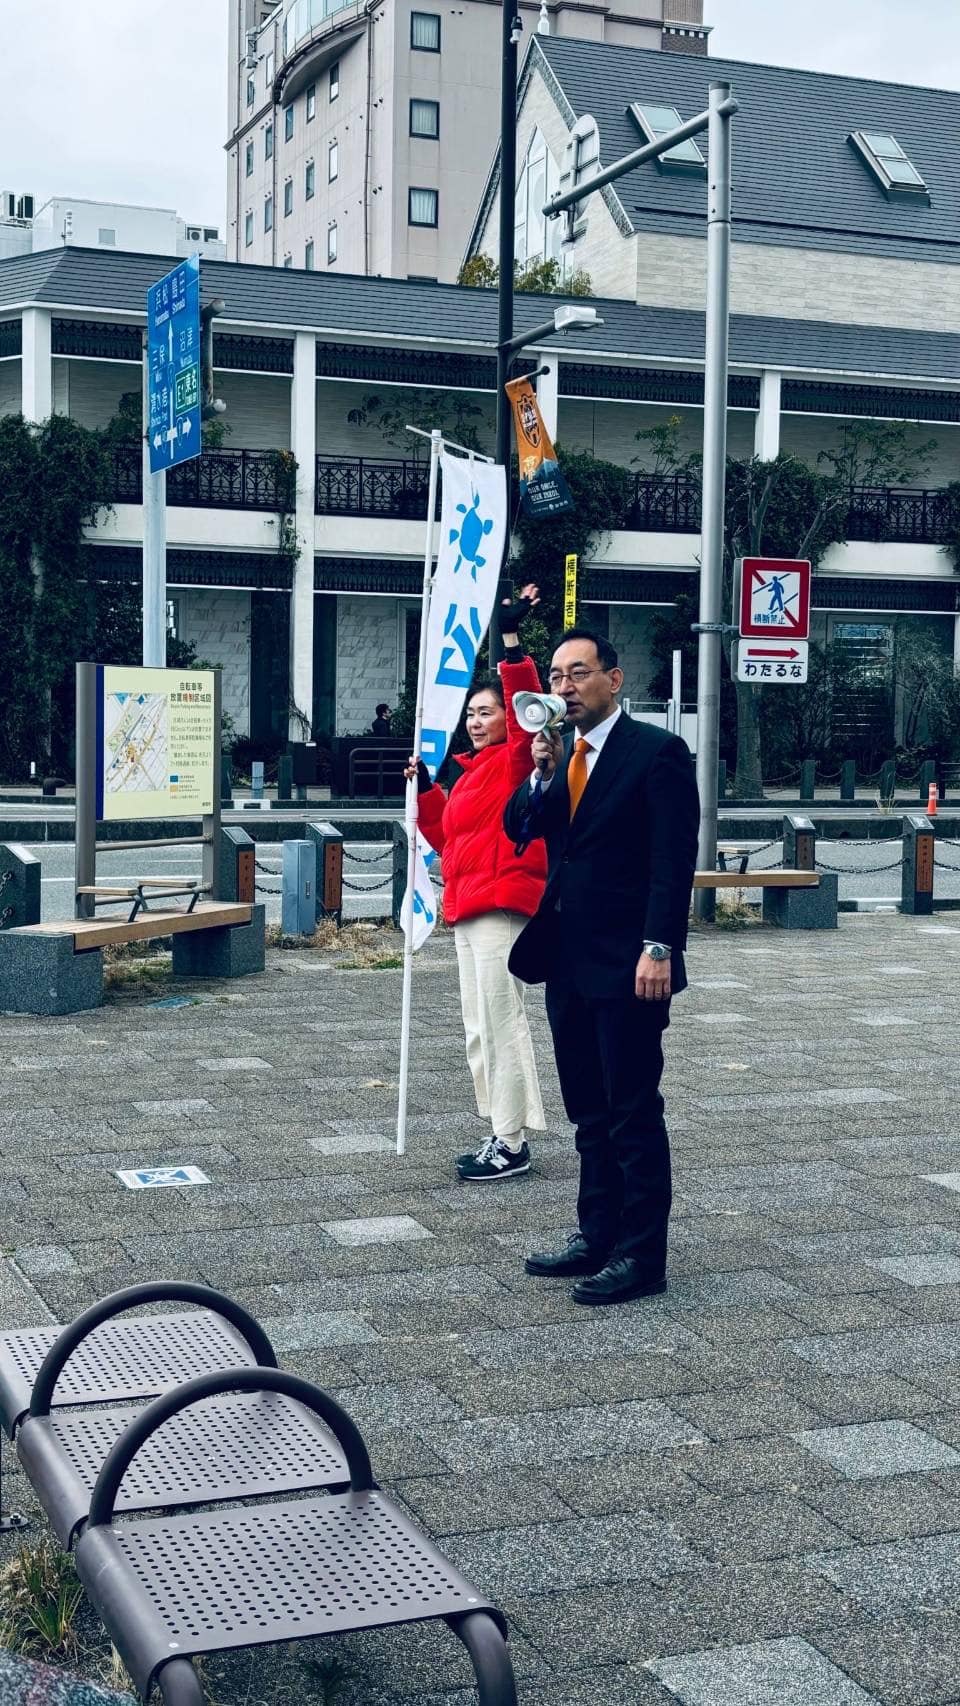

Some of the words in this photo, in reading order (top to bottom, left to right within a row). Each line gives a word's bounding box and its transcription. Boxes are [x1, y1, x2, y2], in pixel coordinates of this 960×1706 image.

[754, 613, 786, 625] 横断禁止
[744, 663, 802, 678] わたるな
[179, 682, 203, 691] 自転車等
